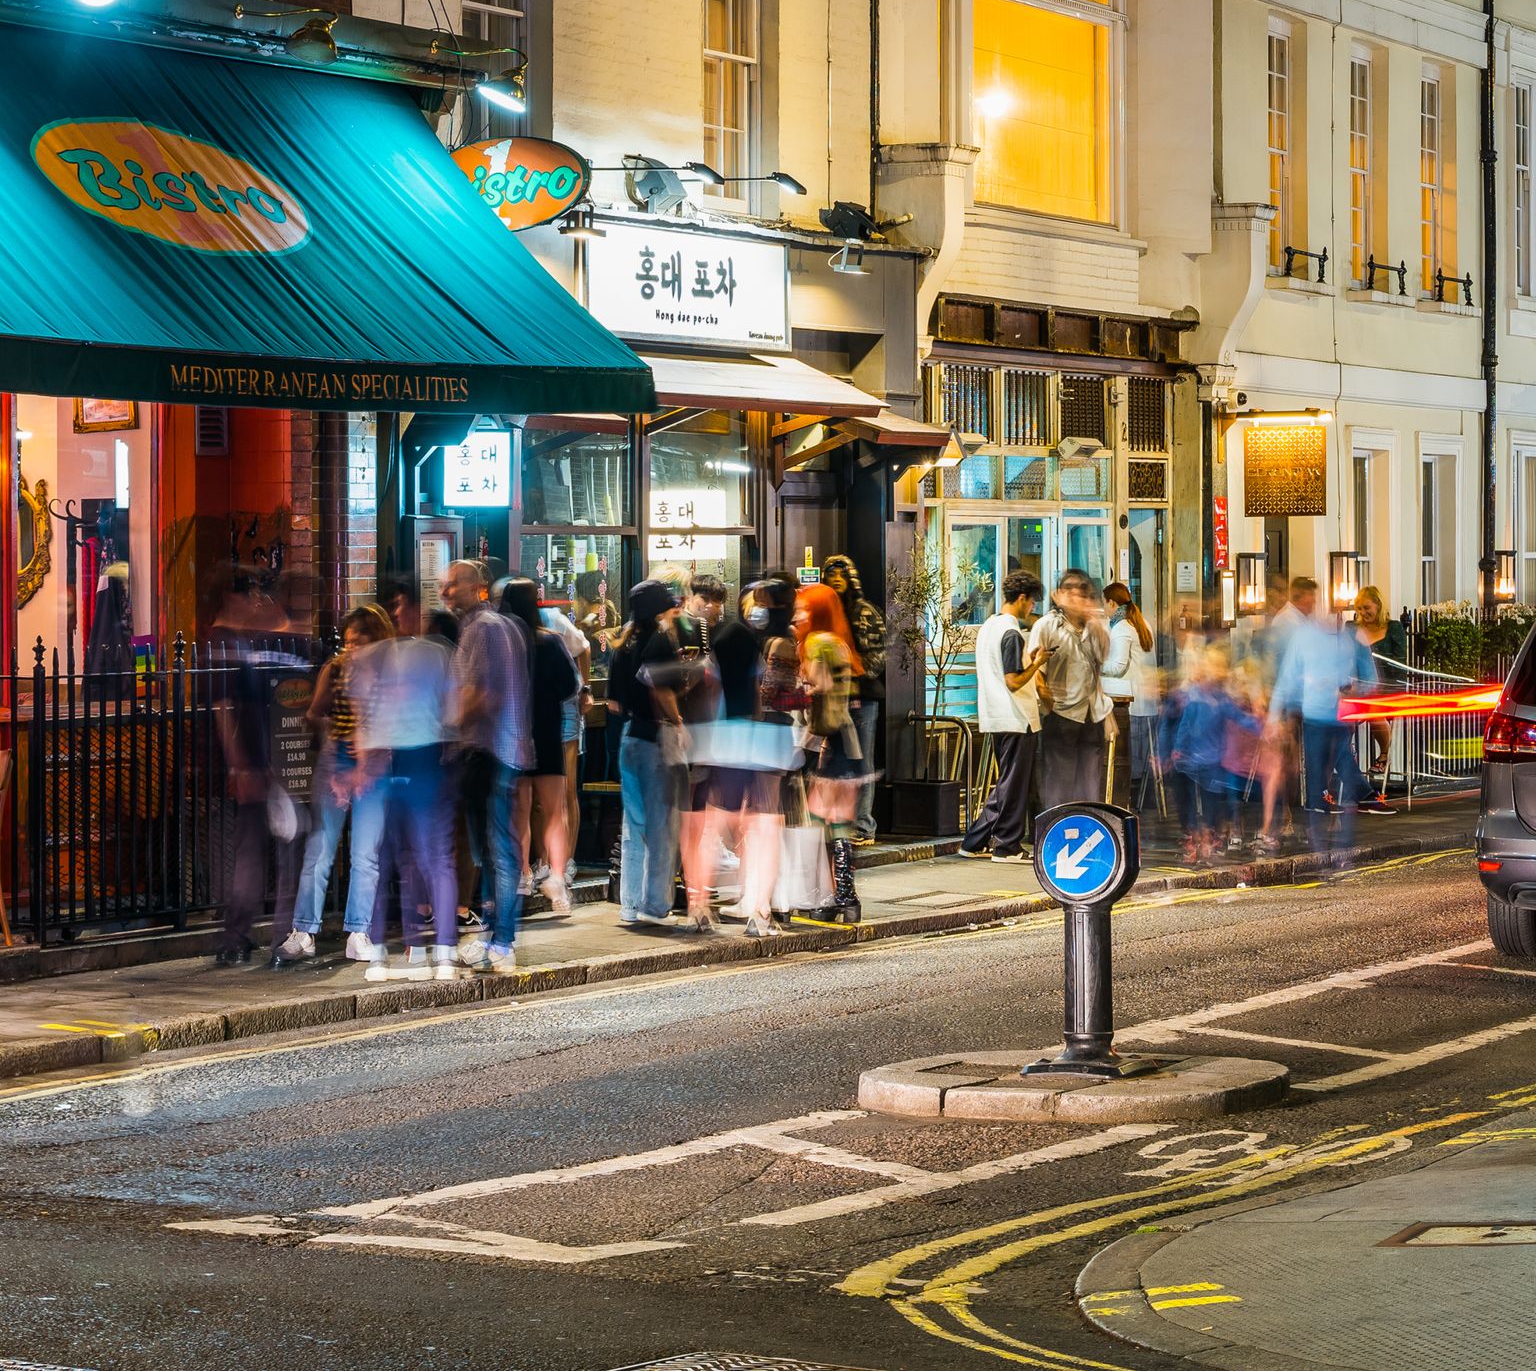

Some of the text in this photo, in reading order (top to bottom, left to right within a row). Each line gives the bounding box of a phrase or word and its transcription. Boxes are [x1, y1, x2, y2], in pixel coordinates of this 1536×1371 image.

[57, 148, 286, 224] Bistro
[470, 164, 581, 208] istro
[635, 245, 738, 308] 홍대 포차
[655, 309, 719, 326] Hong dae po-cha
[170, 364, 469, 403] MEDITERRANEAN SPECIALITIES
[456, 444, 498, 466] 홍대
[456, 474, 498, 494] 포차
[654, 500, 695, 523] 홍대
[282, 767, 312, 776] 3 COURSES
